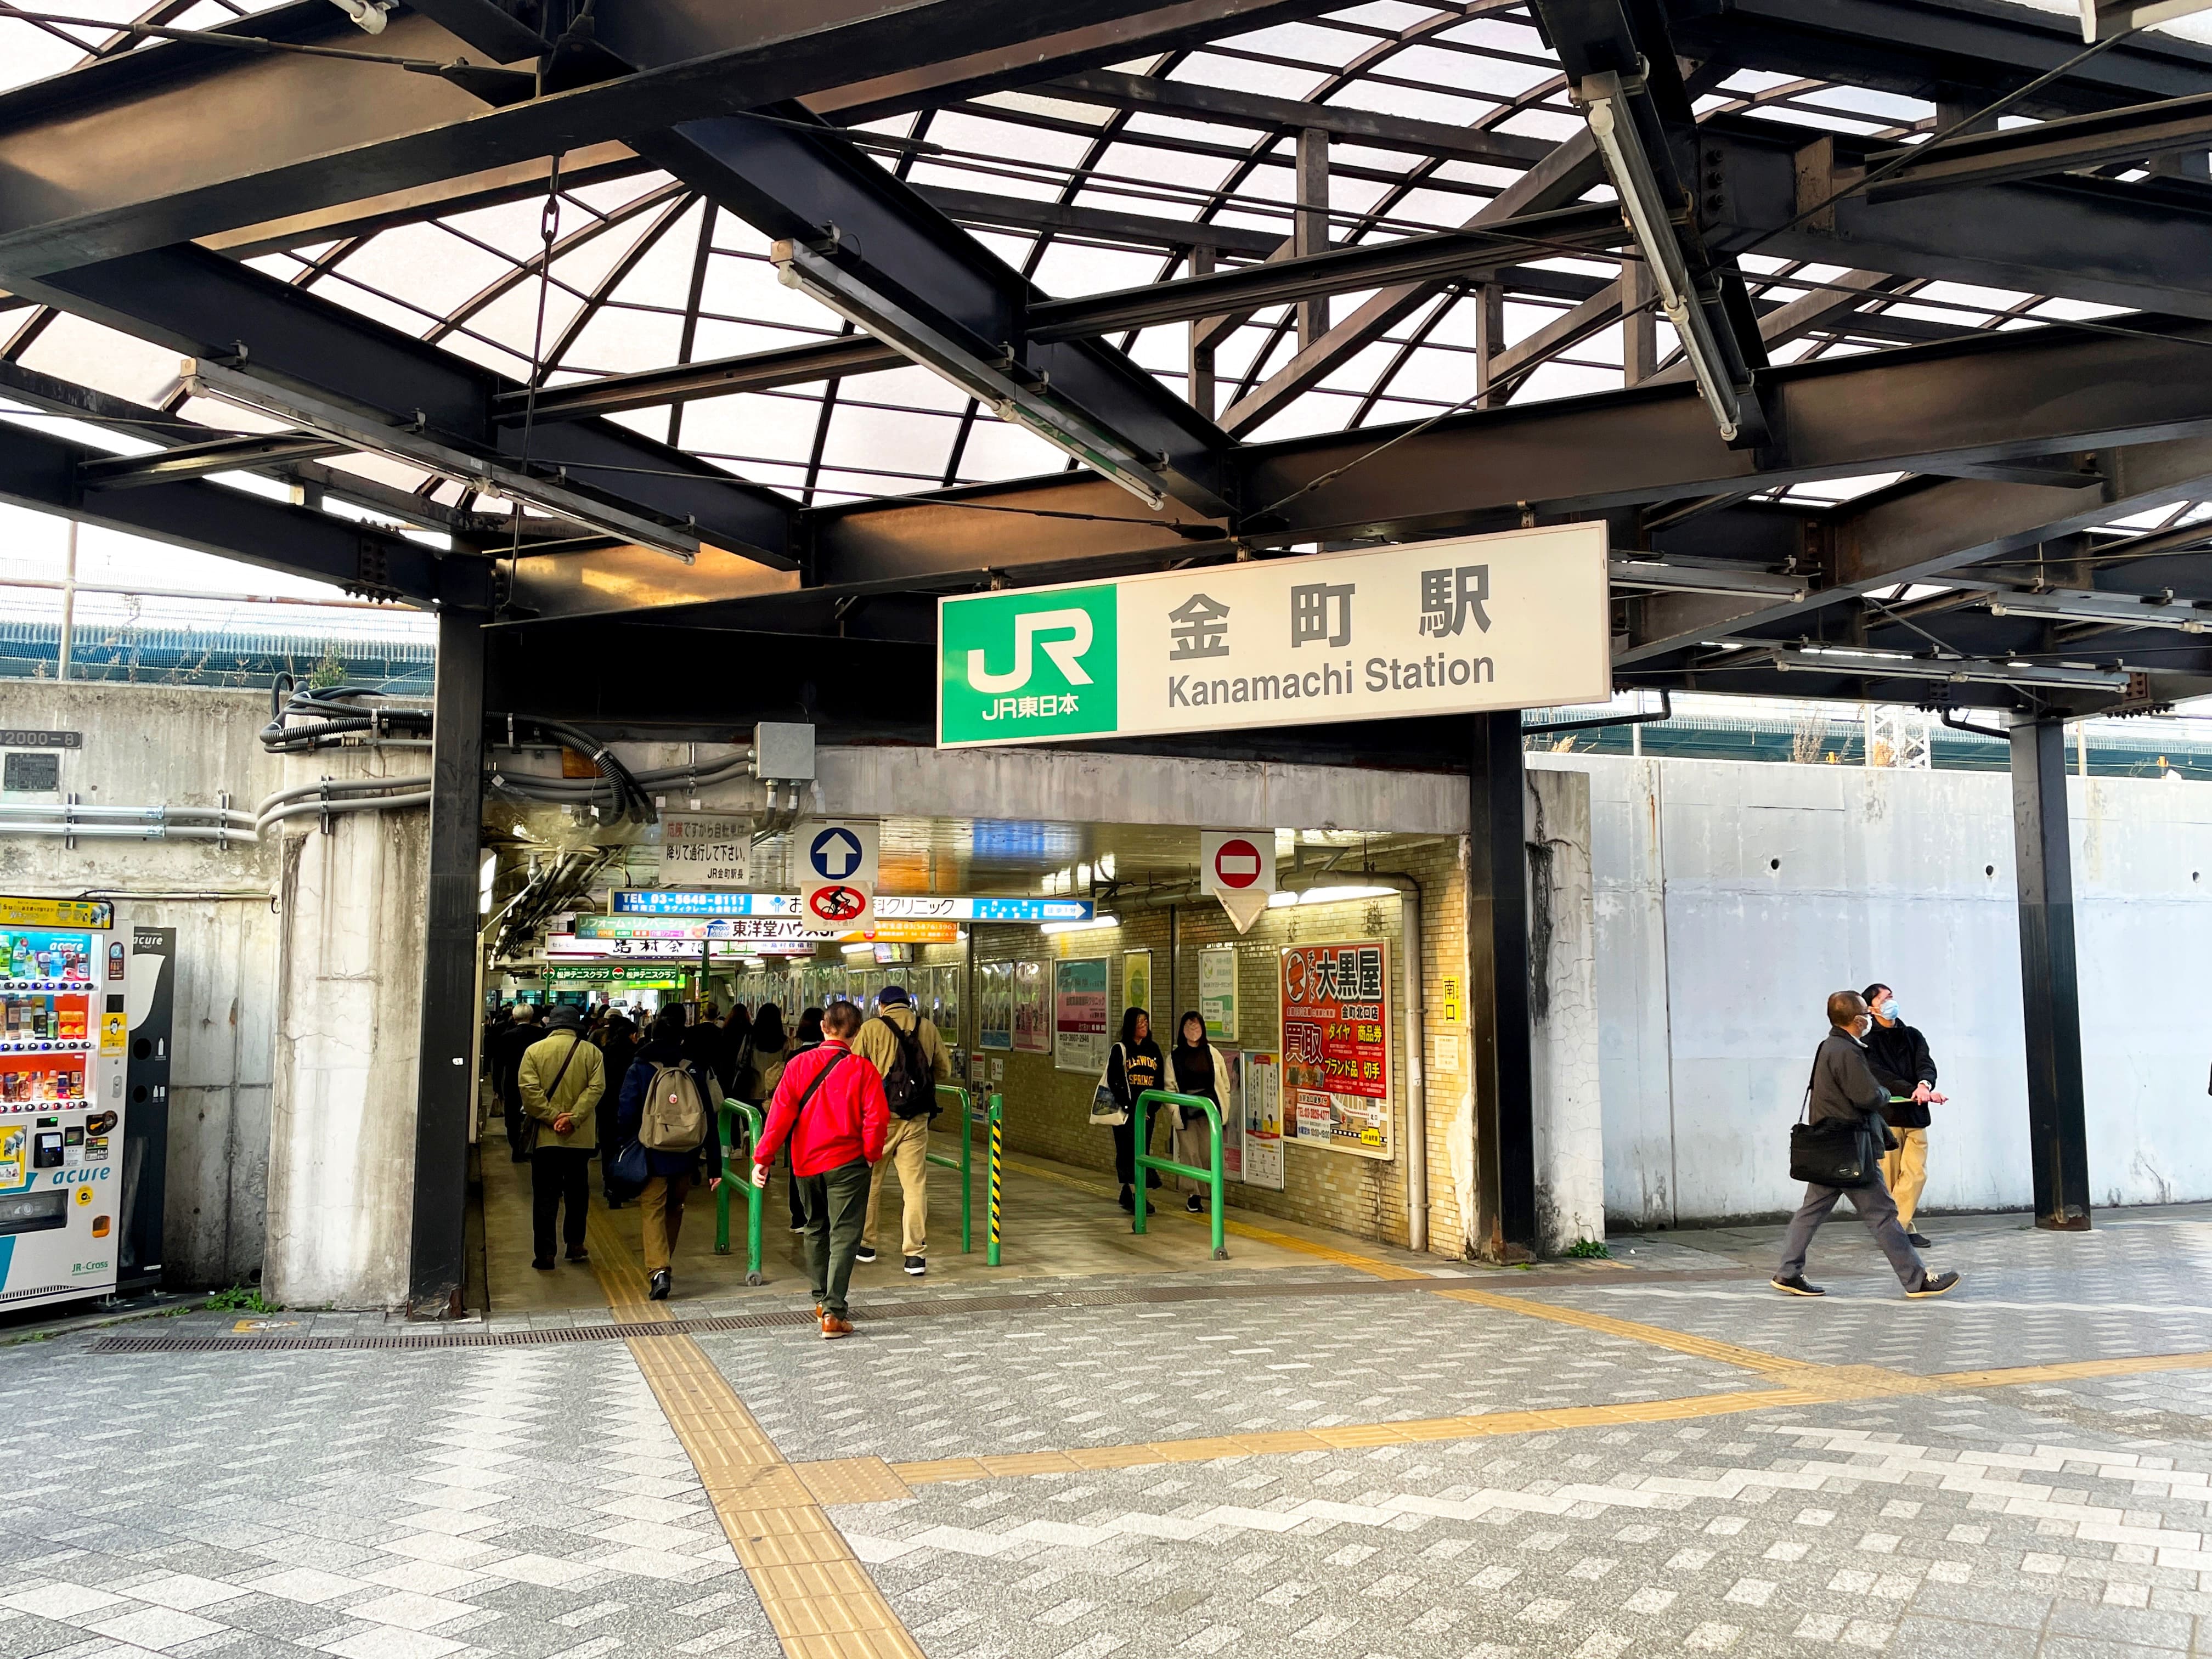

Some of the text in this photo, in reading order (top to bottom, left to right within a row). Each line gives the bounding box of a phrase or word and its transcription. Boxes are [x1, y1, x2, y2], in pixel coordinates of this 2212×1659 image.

[1169, 563, 1493, 661] 金町駅
[967, 607, 1094, 695] JR
[1169, 655, 1494, 709] Kanamachi Station
[982, 692, 1080, 721] JR東日本
[0, 731, 74, 746] 2000-8
[667, 843, 746, 862] 降りて通行して下さい。
[707, 867, 744, 879] JR金町駅長
[623, 894, 744, 905] TEL 03-5648-8111
[133, 936, 163, 945] acure
[556, 970, 610, 979] 松戸テニスクラブ
[1307, 950, 1315, 1003] チケット
[1316, 947, 1383, 1001] 大黒屋
[1444, 979, 1455, 1021] 南口
[1341, 1005, 1379, 1020] 金町北口店
[1329, 1023, 1351, 1041] ダイヤ
[1357, 1024, 1383, 1043] 商品券
[1285, 1022, 1324, 1064] 買取
[1324, 1059, 1358, 1078] ブランド品
[1363, 1061, 1380, 1080] 切手
[53, 1166, 111, 1185] acure
[71, 1261, 108, 1273] JR-Cross
